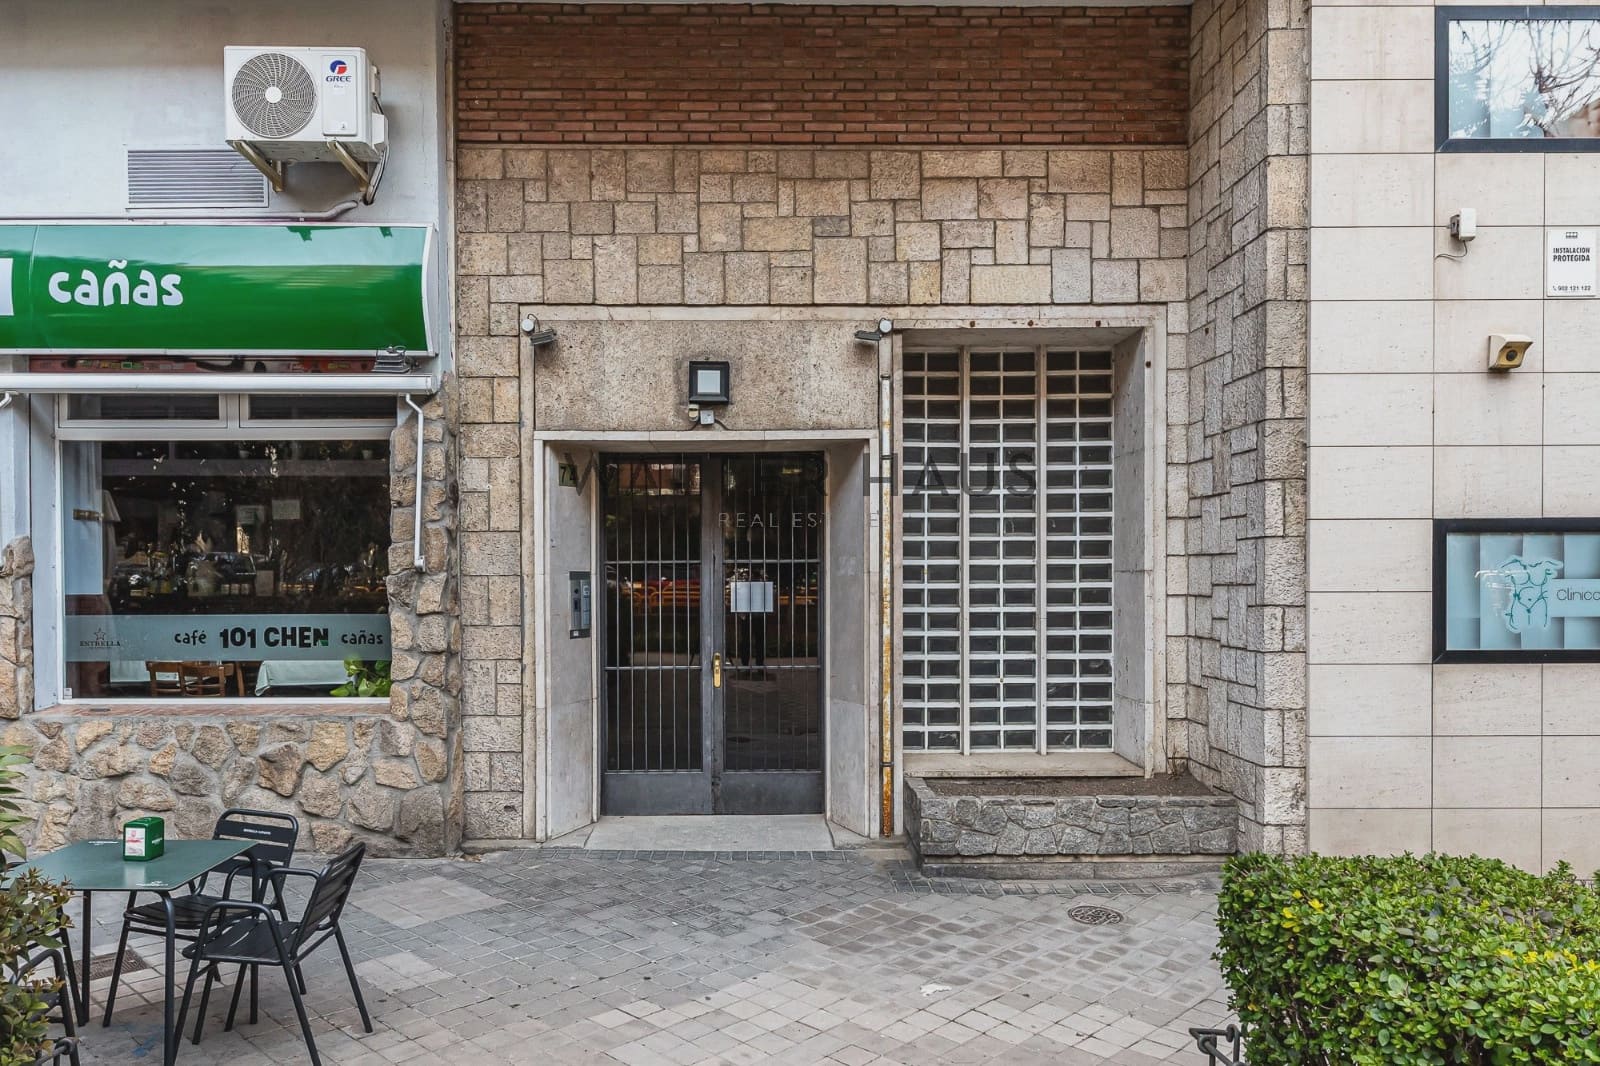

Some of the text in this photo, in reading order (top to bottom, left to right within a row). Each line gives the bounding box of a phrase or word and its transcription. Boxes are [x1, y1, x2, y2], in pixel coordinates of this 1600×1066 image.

[325, 75, 353, 83] GREE
[1552, 254, 1591, 262] PROTEGIDA
[48, 259, 184, 307] cañas
[174, 626, 384, 649] café 101 CHEN cañas
